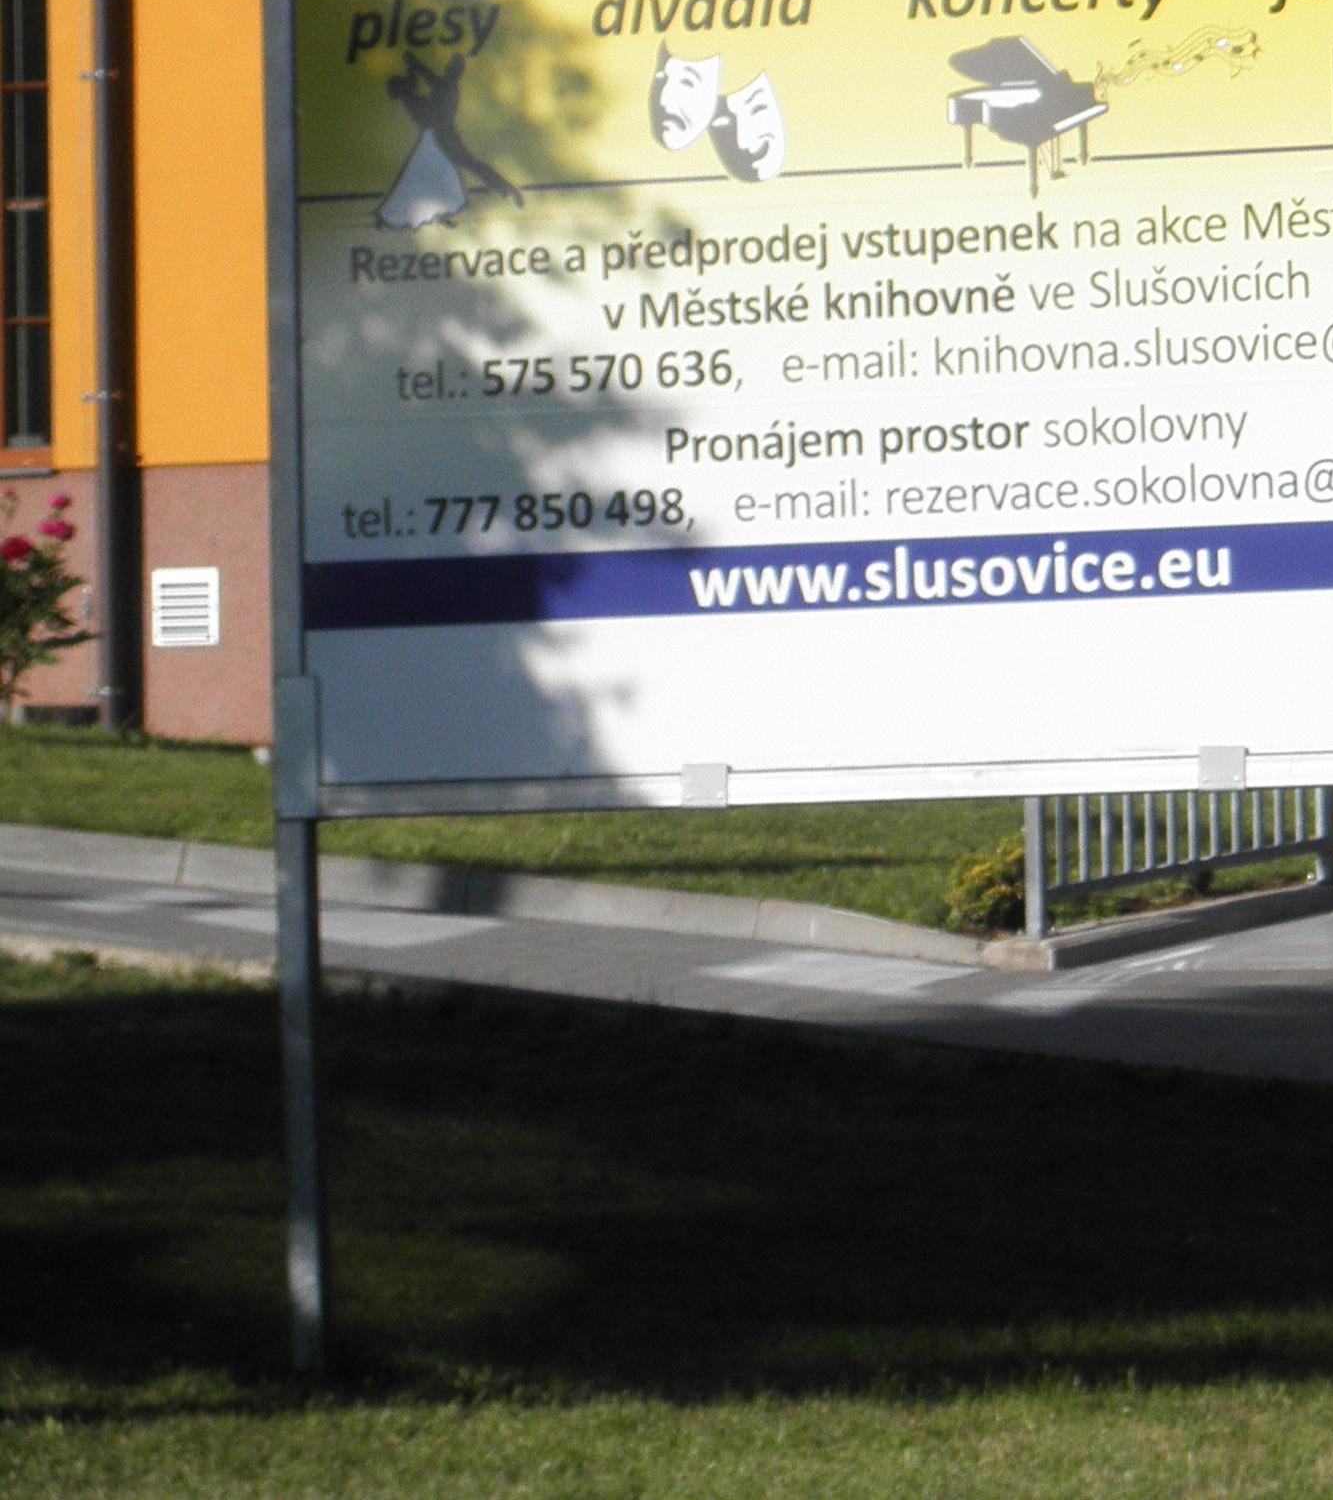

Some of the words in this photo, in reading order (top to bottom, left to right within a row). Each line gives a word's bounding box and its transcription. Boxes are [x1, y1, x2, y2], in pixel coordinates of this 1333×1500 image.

[351, 243, 550, 283] Rezervace
[565, 246, 585, 272] a
[601, 223, 828, 280] předprodej
[841, 211, 1058, 266] vstupenek
[1074, 217, 1121, 248] na
[1136, 204, 1228, 247] akce
[603, 303, 624, 330] v
[638, 283, 809, 330] Městské
[824, 273, 1015, 321] knihovně
[1029, 279, 1075, 313] ve
[1089, 259, 1310, 309] Slušovicích
[397, 364, 469, 400] tel.:
[481, 358, 555, 396] 575
[569, 353, 642, 391] 570
[657, 349, 743, 391] 636,
[781, 338, 919, 383] e-mail:
[665, 421, 864, 468] Pronájem
[879, 416, 1030, 465] prostor
[1044, 404, 1248, 451] sokolovny
[341, 500, 414, 540] tel.:
[423, 496, 499, 535] 777
[514, 492, 594, 532] 850
[605, 487, 696, 531] 498,
[735, 478, 870, 522] e-mail:
[689, 542, 1232, 607] www.slusovice.eu
